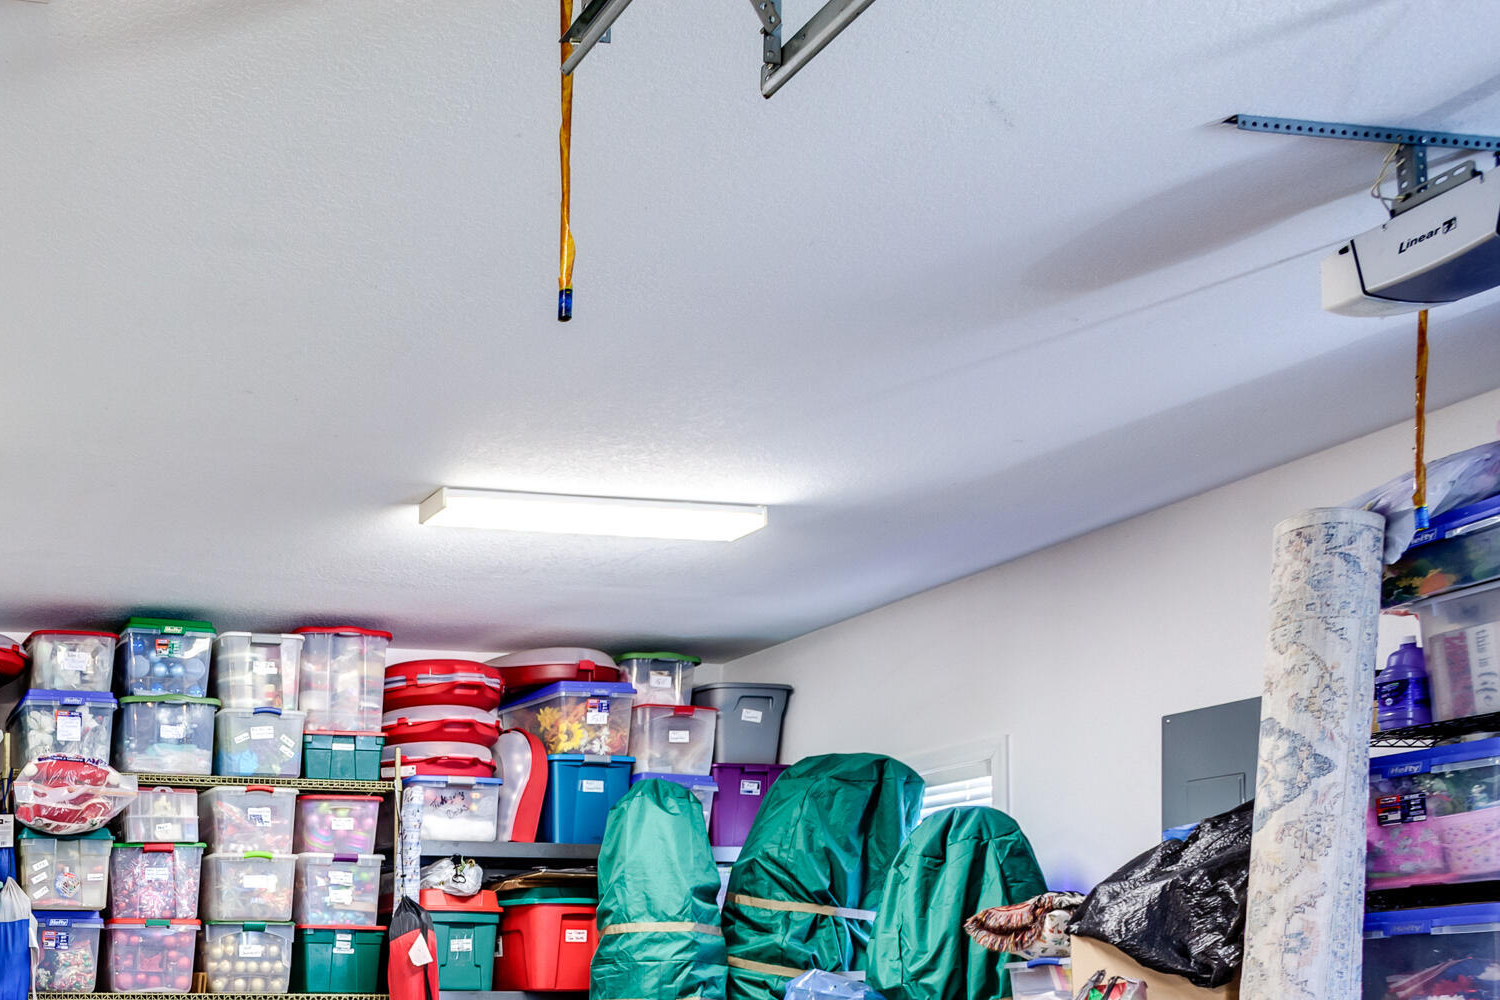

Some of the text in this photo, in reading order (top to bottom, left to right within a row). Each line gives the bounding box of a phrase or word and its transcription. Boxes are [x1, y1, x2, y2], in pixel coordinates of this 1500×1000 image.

[1398, 226, 1442, 254] Linear
[1390, 764, 1421, 775] Hefty
[49, 918, 69, 927] Hefty
